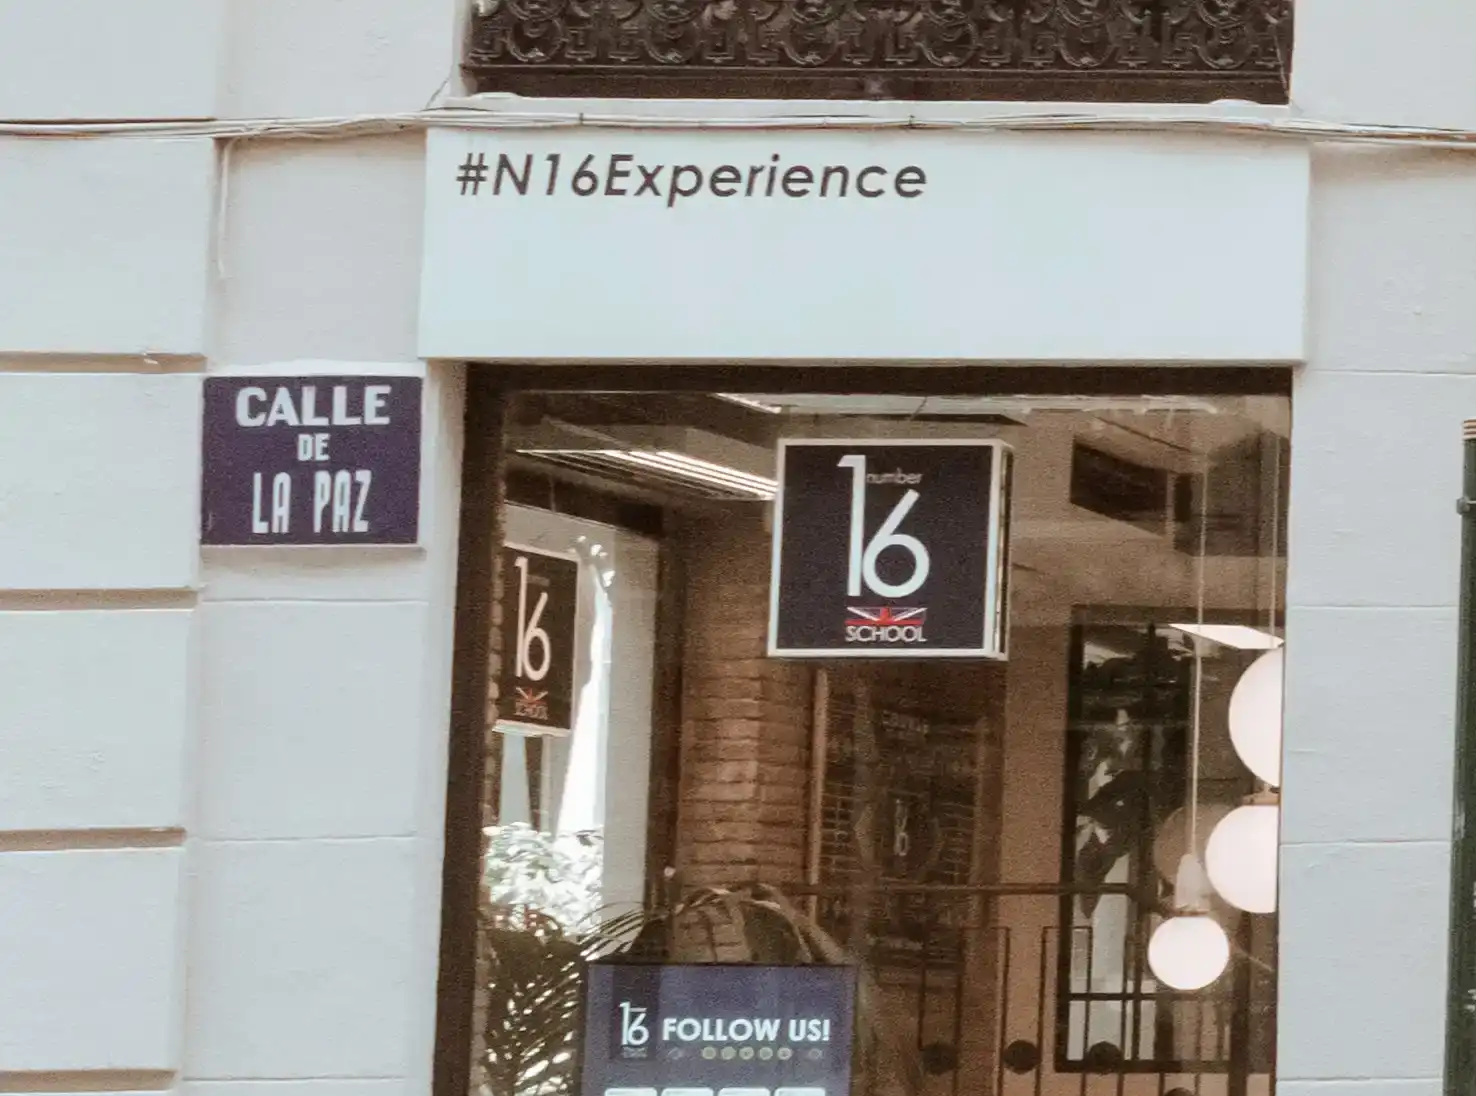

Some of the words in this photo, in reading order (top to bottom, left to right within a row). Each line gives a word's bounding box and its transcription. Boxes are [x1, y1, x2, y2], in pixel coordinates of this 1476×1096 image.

[456, 152, 927, 207] #N16Experience
[235, 385, 392, 427] CALLE
[297, 433, 331, 462] DE
[866, 468, 923, 484] number
[252, 472, 292, 534] LA
[313, 469, 372, 534] PAZ
[837, 454, 930, 598] 16
[514, 556, 551, 681] 16
[845, 625, 928, 642] SCHOOL
[619, 1001, 649, 1046] 16
[662, 1018, 780, 1042] FOLLOW
[789, 1018, 830, 1042] US!
